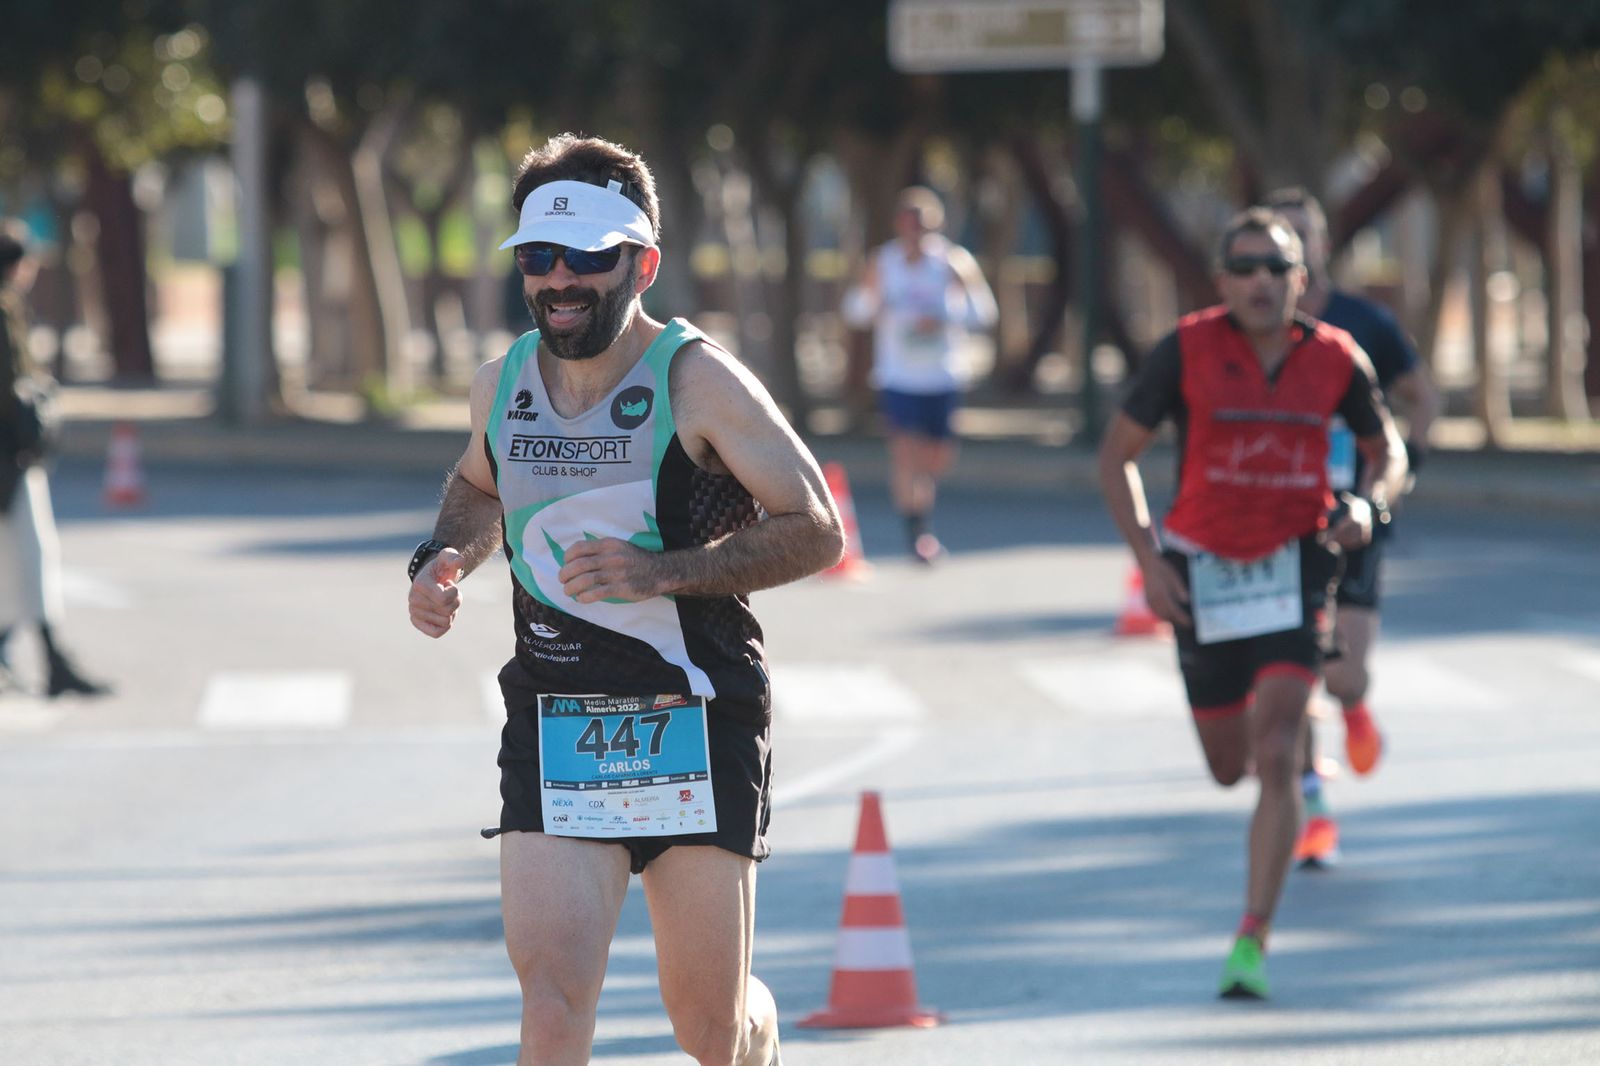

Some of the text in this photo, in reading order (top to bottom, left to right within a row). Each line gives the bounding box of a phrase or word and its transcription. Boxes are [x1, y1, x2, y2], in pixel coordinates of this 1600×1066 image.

[507, 410, 538, 422] VATOR
[509, 439, 632, 460] ETONSPORT
[532, 465, 597, 477] CLUB & SHOP
[607, 697, 639, 705] Maratón
[586, 703, 640, 713] Almería 2022
[575, 711, 672, 761] 447
[599, 759, 651, 774] CARLOS
[552, 799, 573, 807] NEXA
